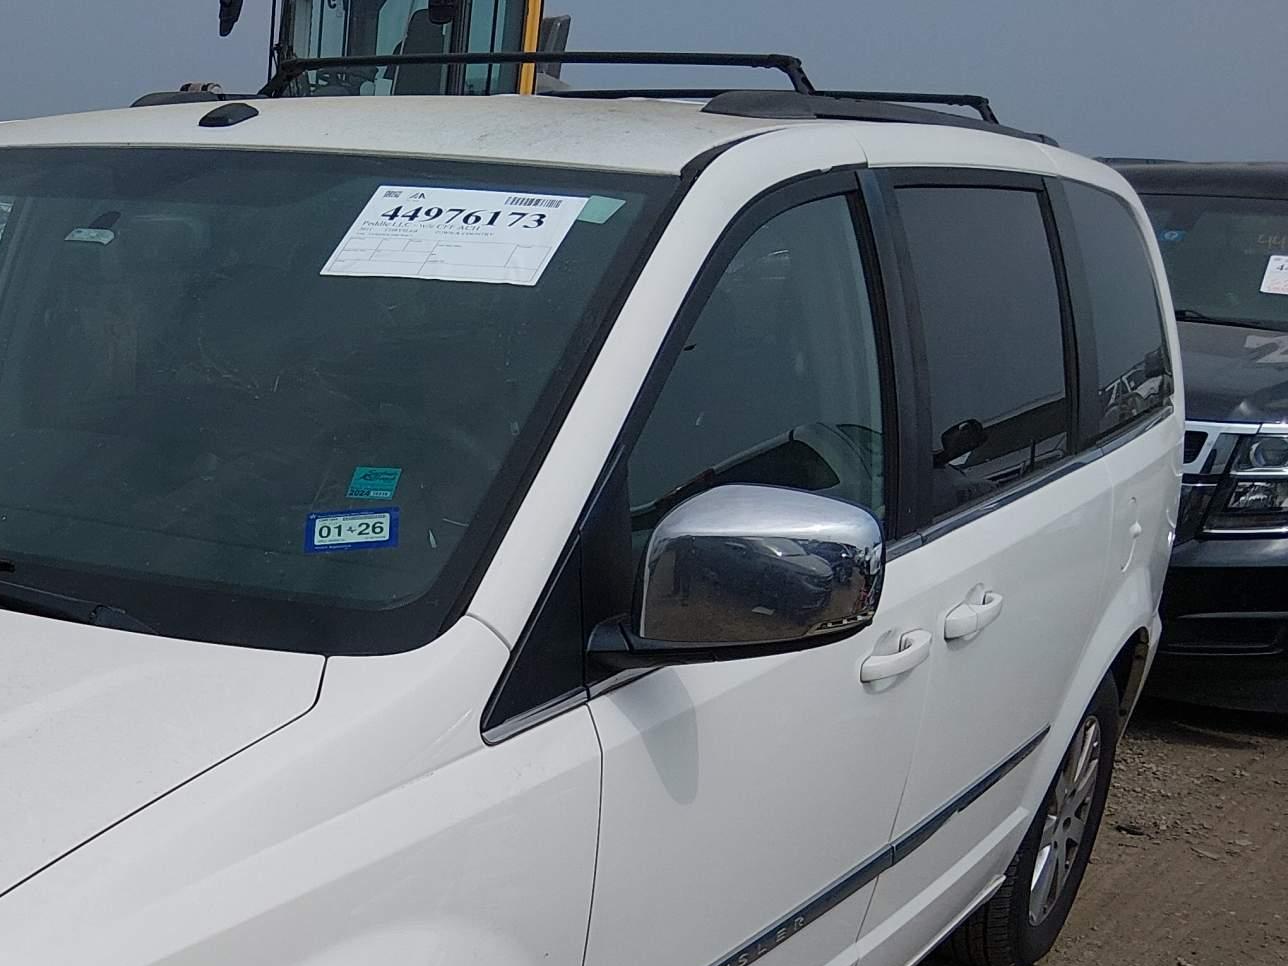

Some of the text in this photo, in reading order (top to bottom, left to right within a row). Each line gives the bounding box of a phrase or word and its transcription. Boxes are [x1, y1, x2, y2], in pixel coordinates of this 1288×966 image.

[381, 205, 546, 228] 44976173
[318, 524, 343, 539] 01
[357, 521, 384, 536] 26
